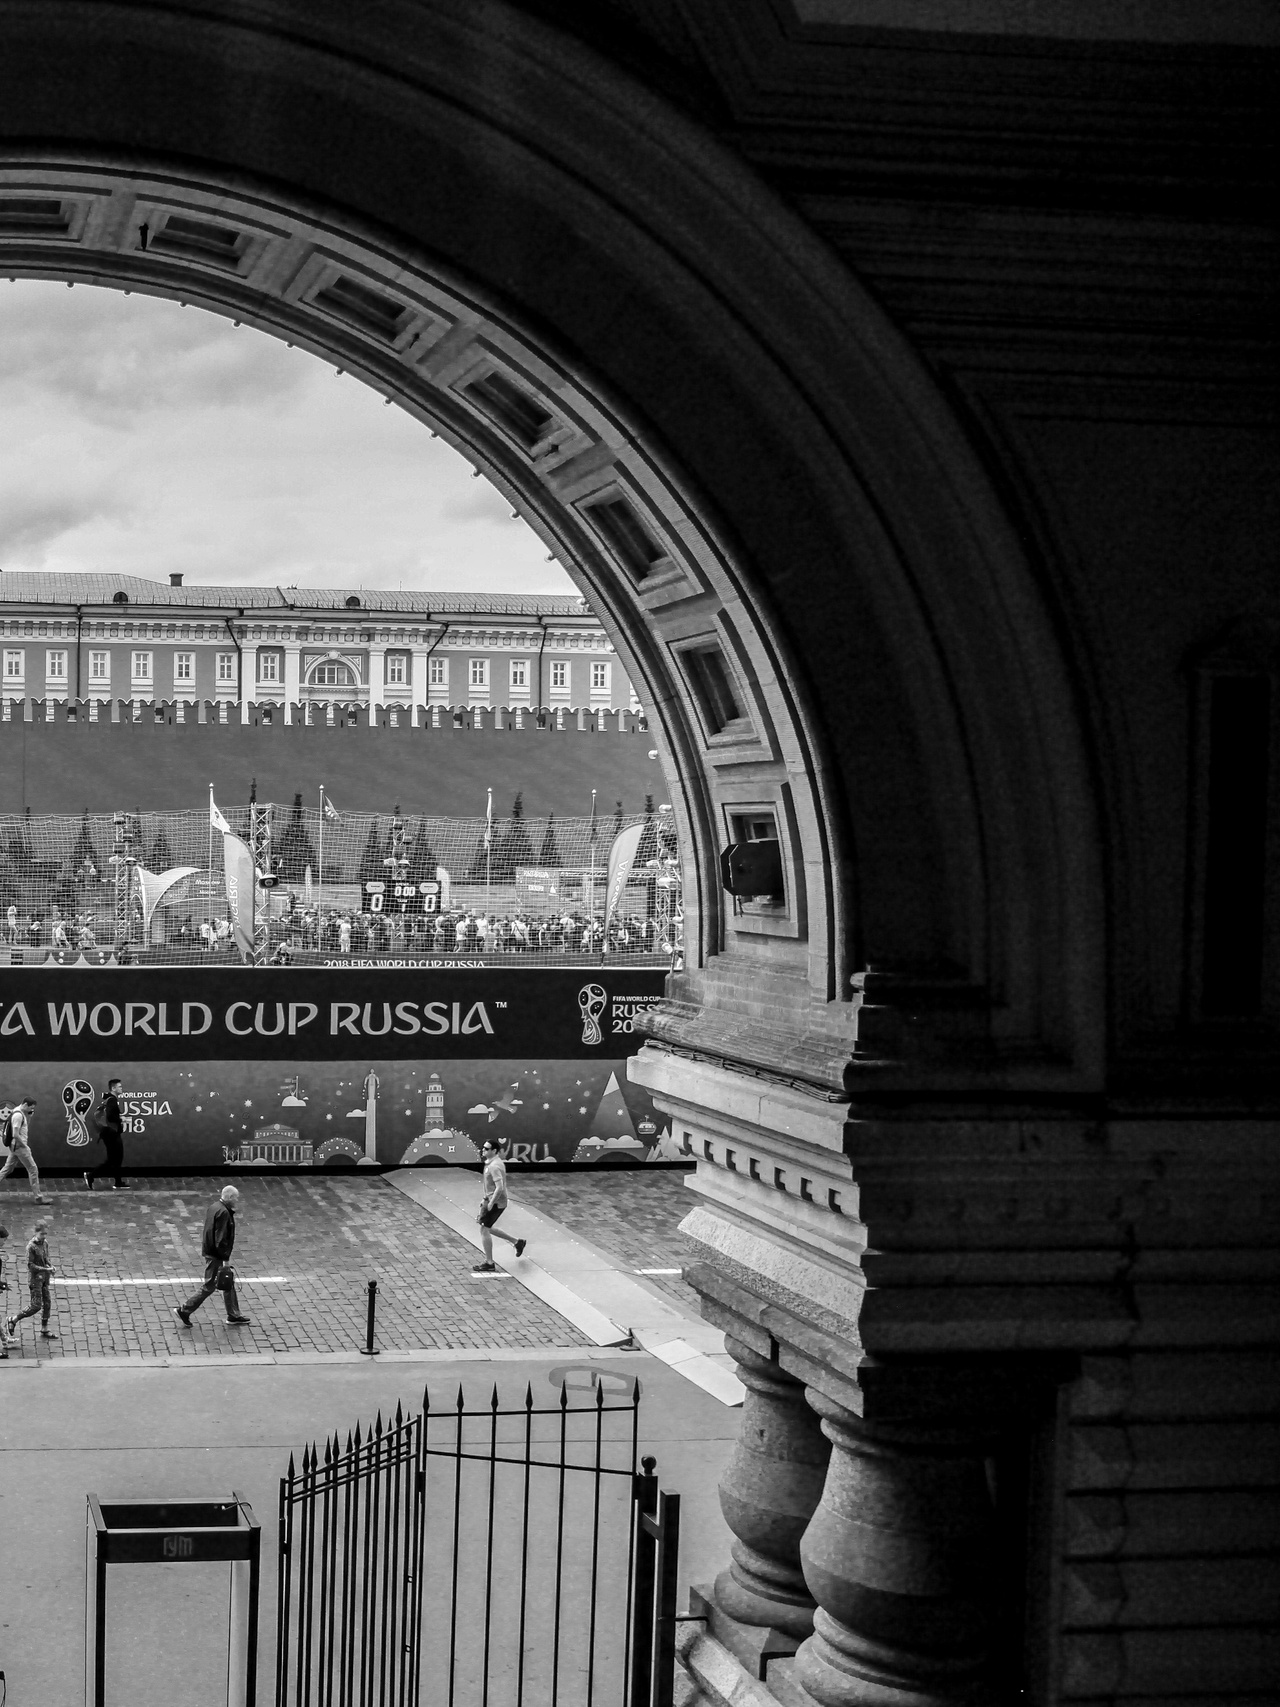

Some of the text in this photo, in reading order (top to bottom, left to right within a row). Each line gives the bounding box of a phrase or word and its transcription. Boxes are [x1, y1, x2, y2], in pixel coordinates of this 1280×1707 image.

[371, 894, 384, 911] 0
[424, 894, 437, 912] 0
[324, 959, 349, 968] 2018
[351, 959, 374, 968] FIFA
[376, 959, 417, 968] WORLD
[47, 1001, 213, 1036] WORLD
[224, 1001, 319, 1036] CUP
[611, 1019, 634, 1034] 20
[118, 1101, 173, 1116] USSIA
